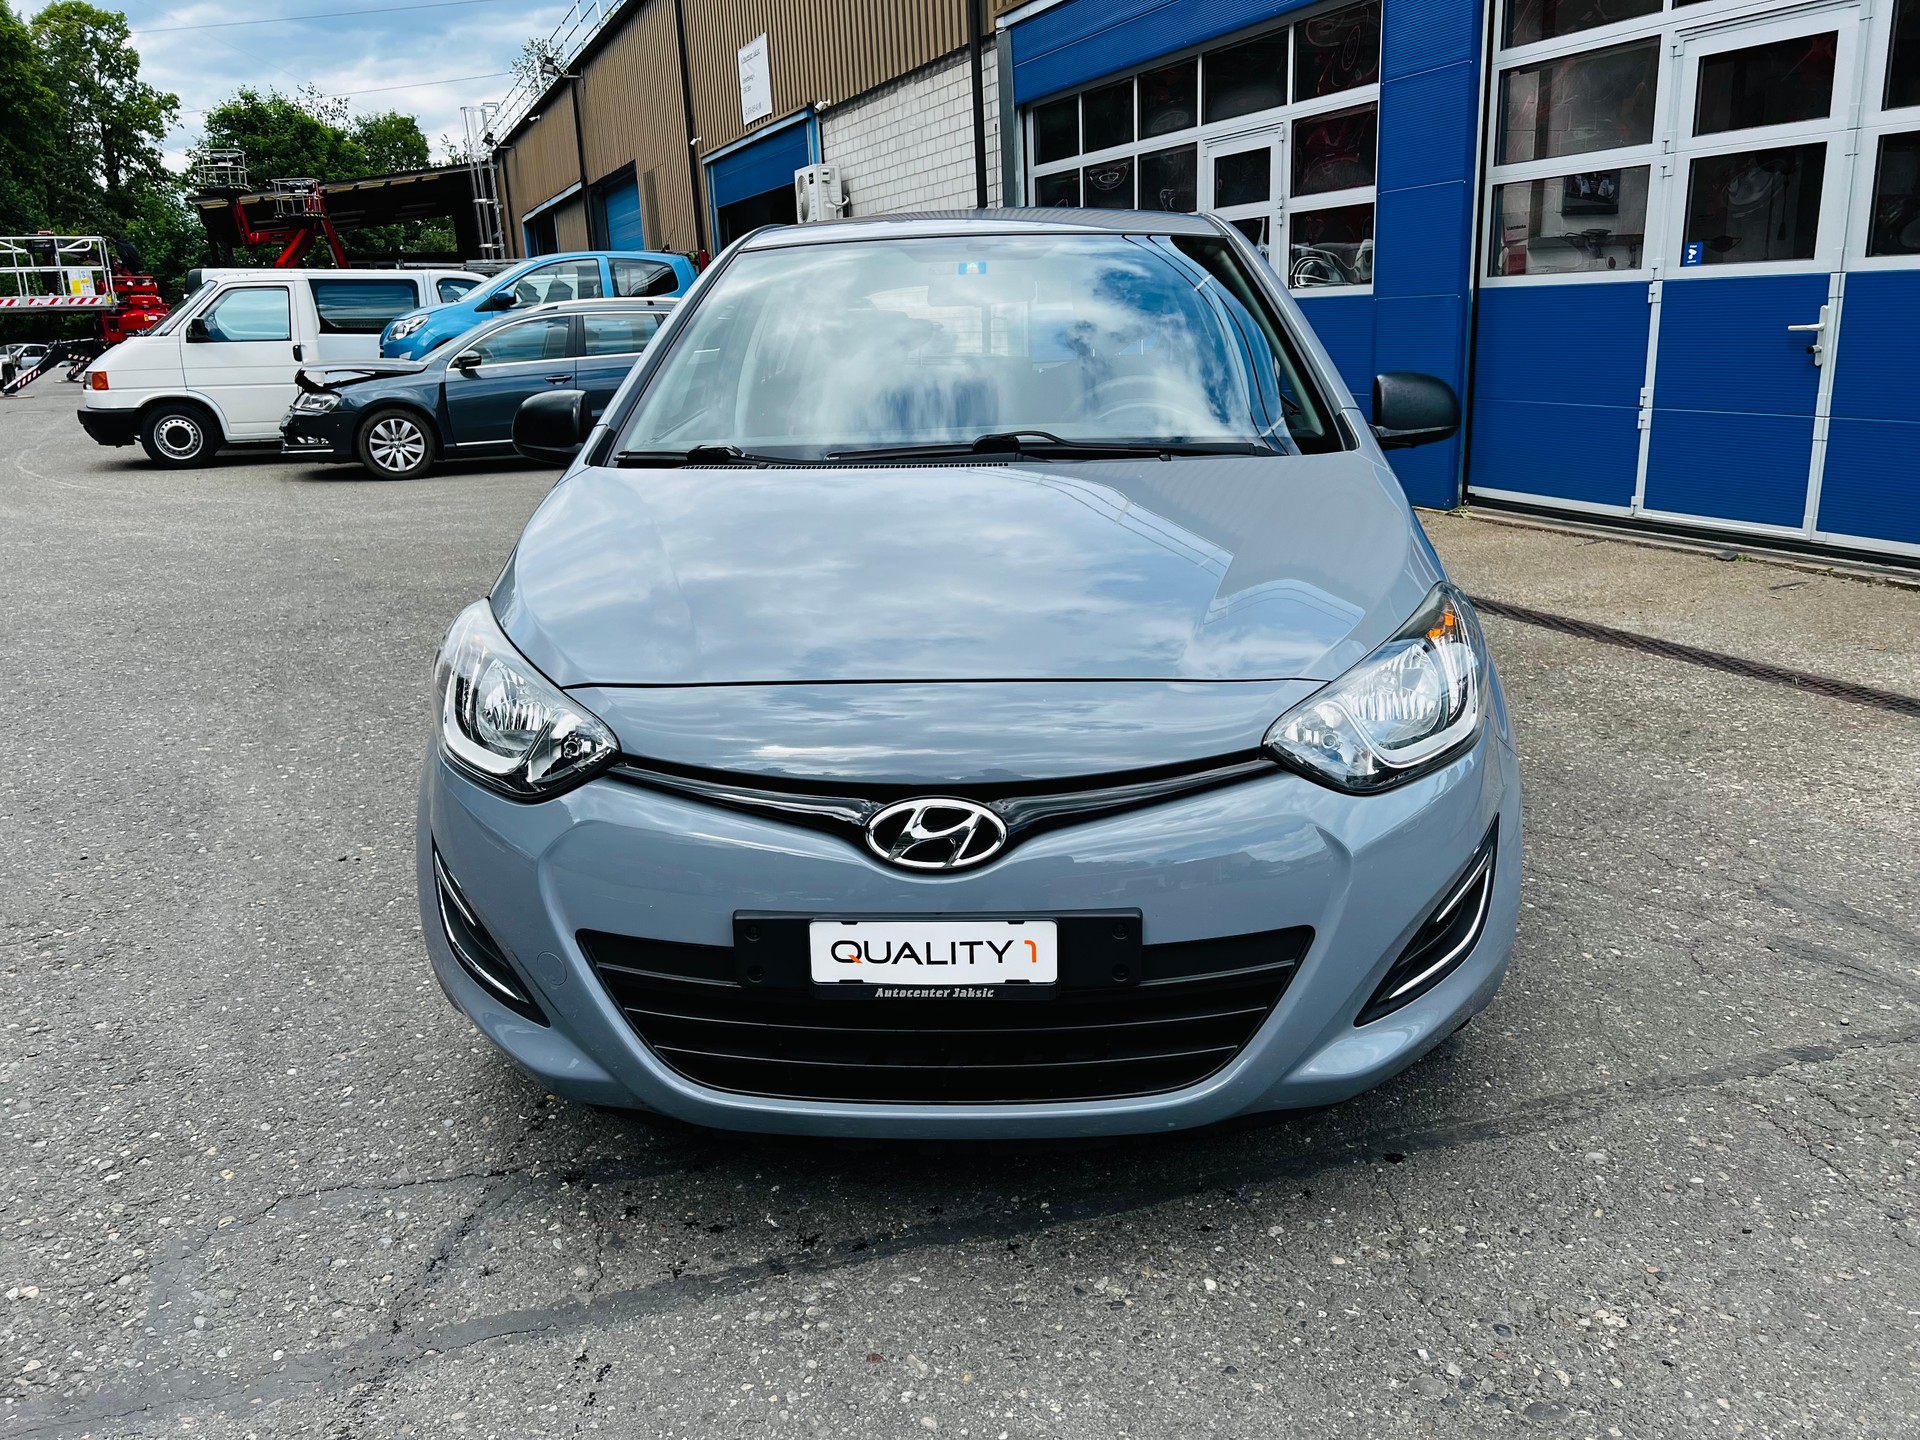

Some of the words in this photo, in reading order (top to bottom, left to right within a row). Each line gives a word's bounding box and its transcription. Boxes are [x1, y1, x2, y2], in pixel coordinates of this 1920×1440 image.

[831, 940, 1014, 965] QUALITY
[875, 988, 951, 998] Autocenter
[952, 988, 995, 998] Jaksic
